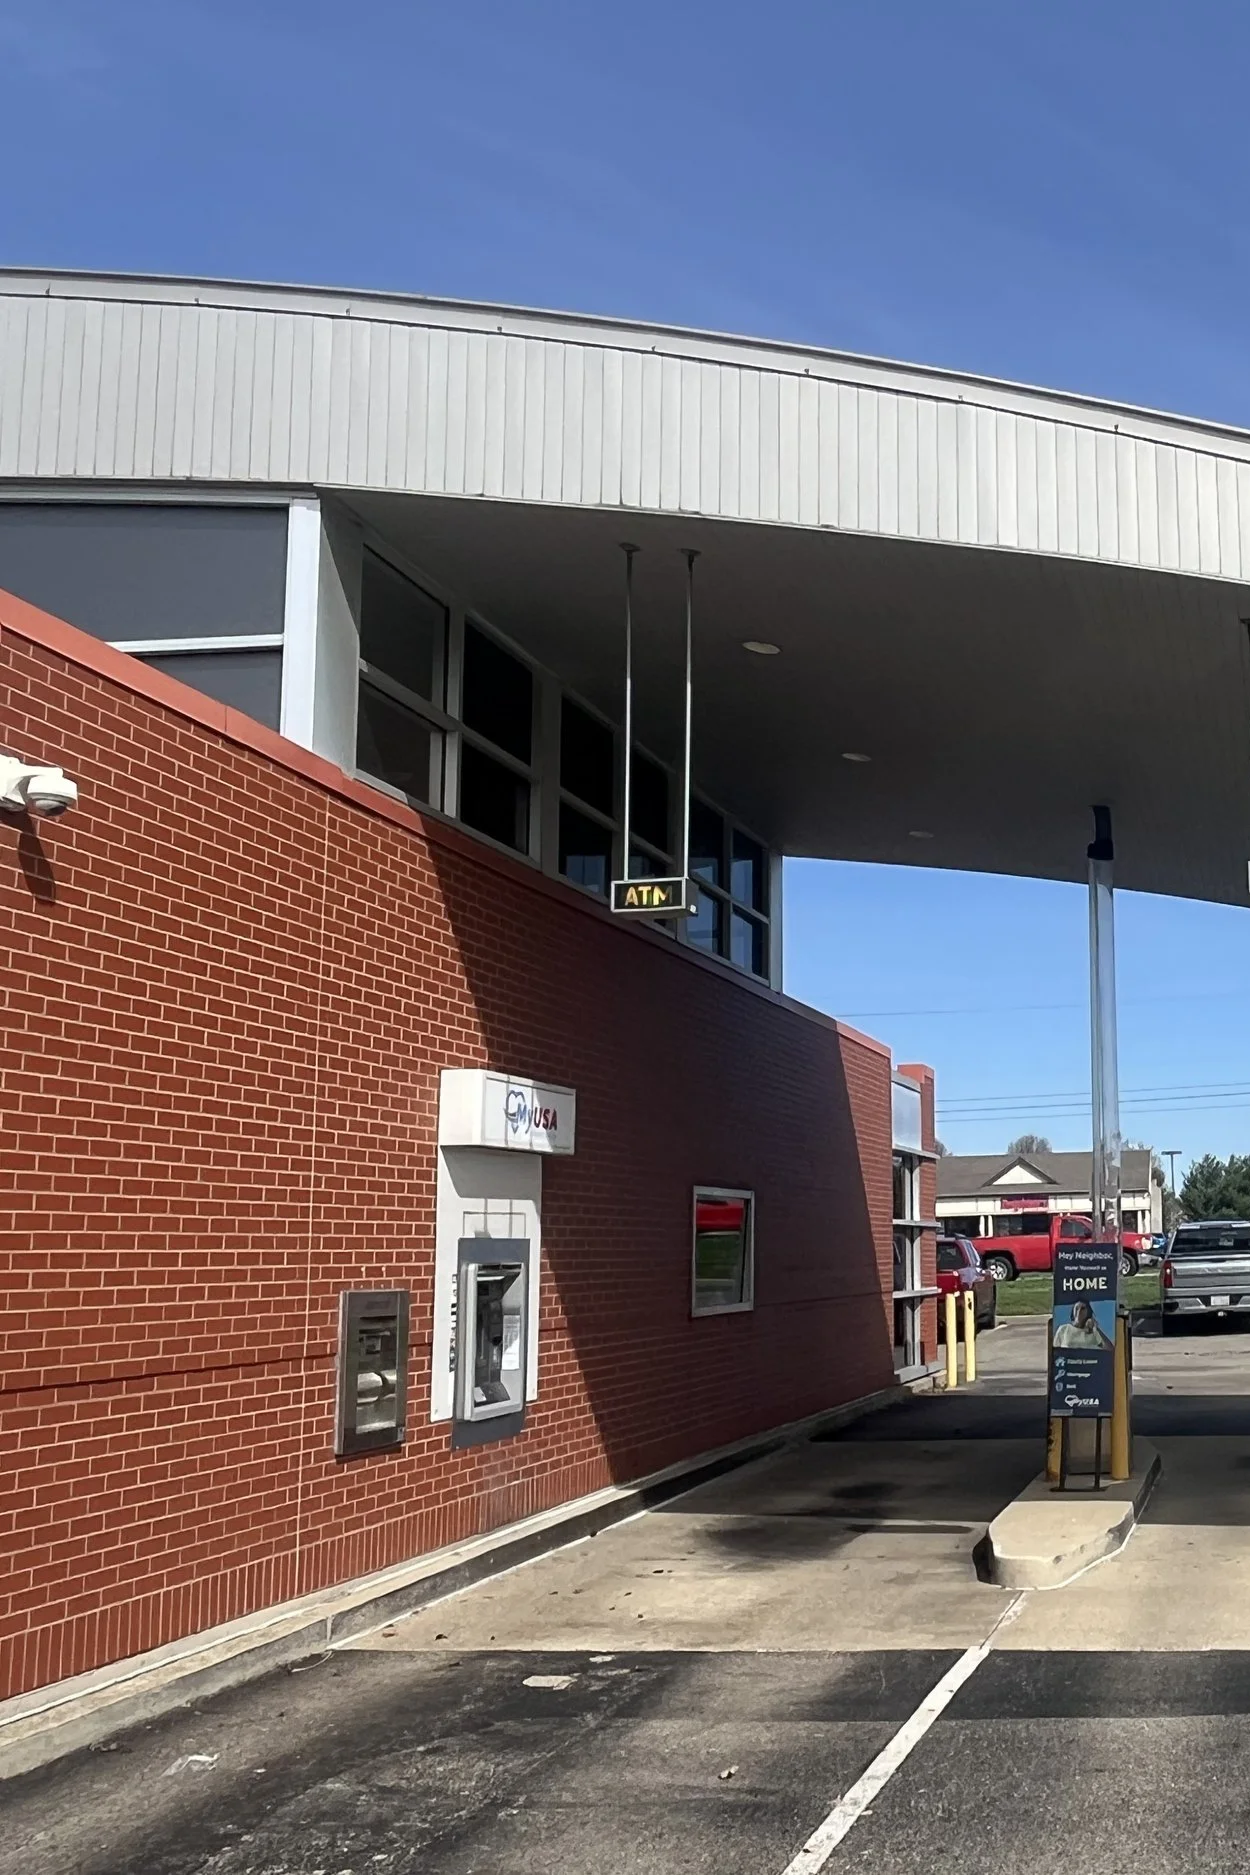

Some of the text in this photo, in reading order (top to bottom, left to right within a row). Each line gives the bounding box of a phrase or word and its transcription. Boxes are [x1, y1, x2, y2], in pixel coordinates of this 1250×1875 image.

[624, 885, 673, 906] ATM
[516, 1102, 558, 1134] MyUSA
[1058, 1251, 1074, 1261] Hey
[1063, 1276, 1108, 1291] HOME
